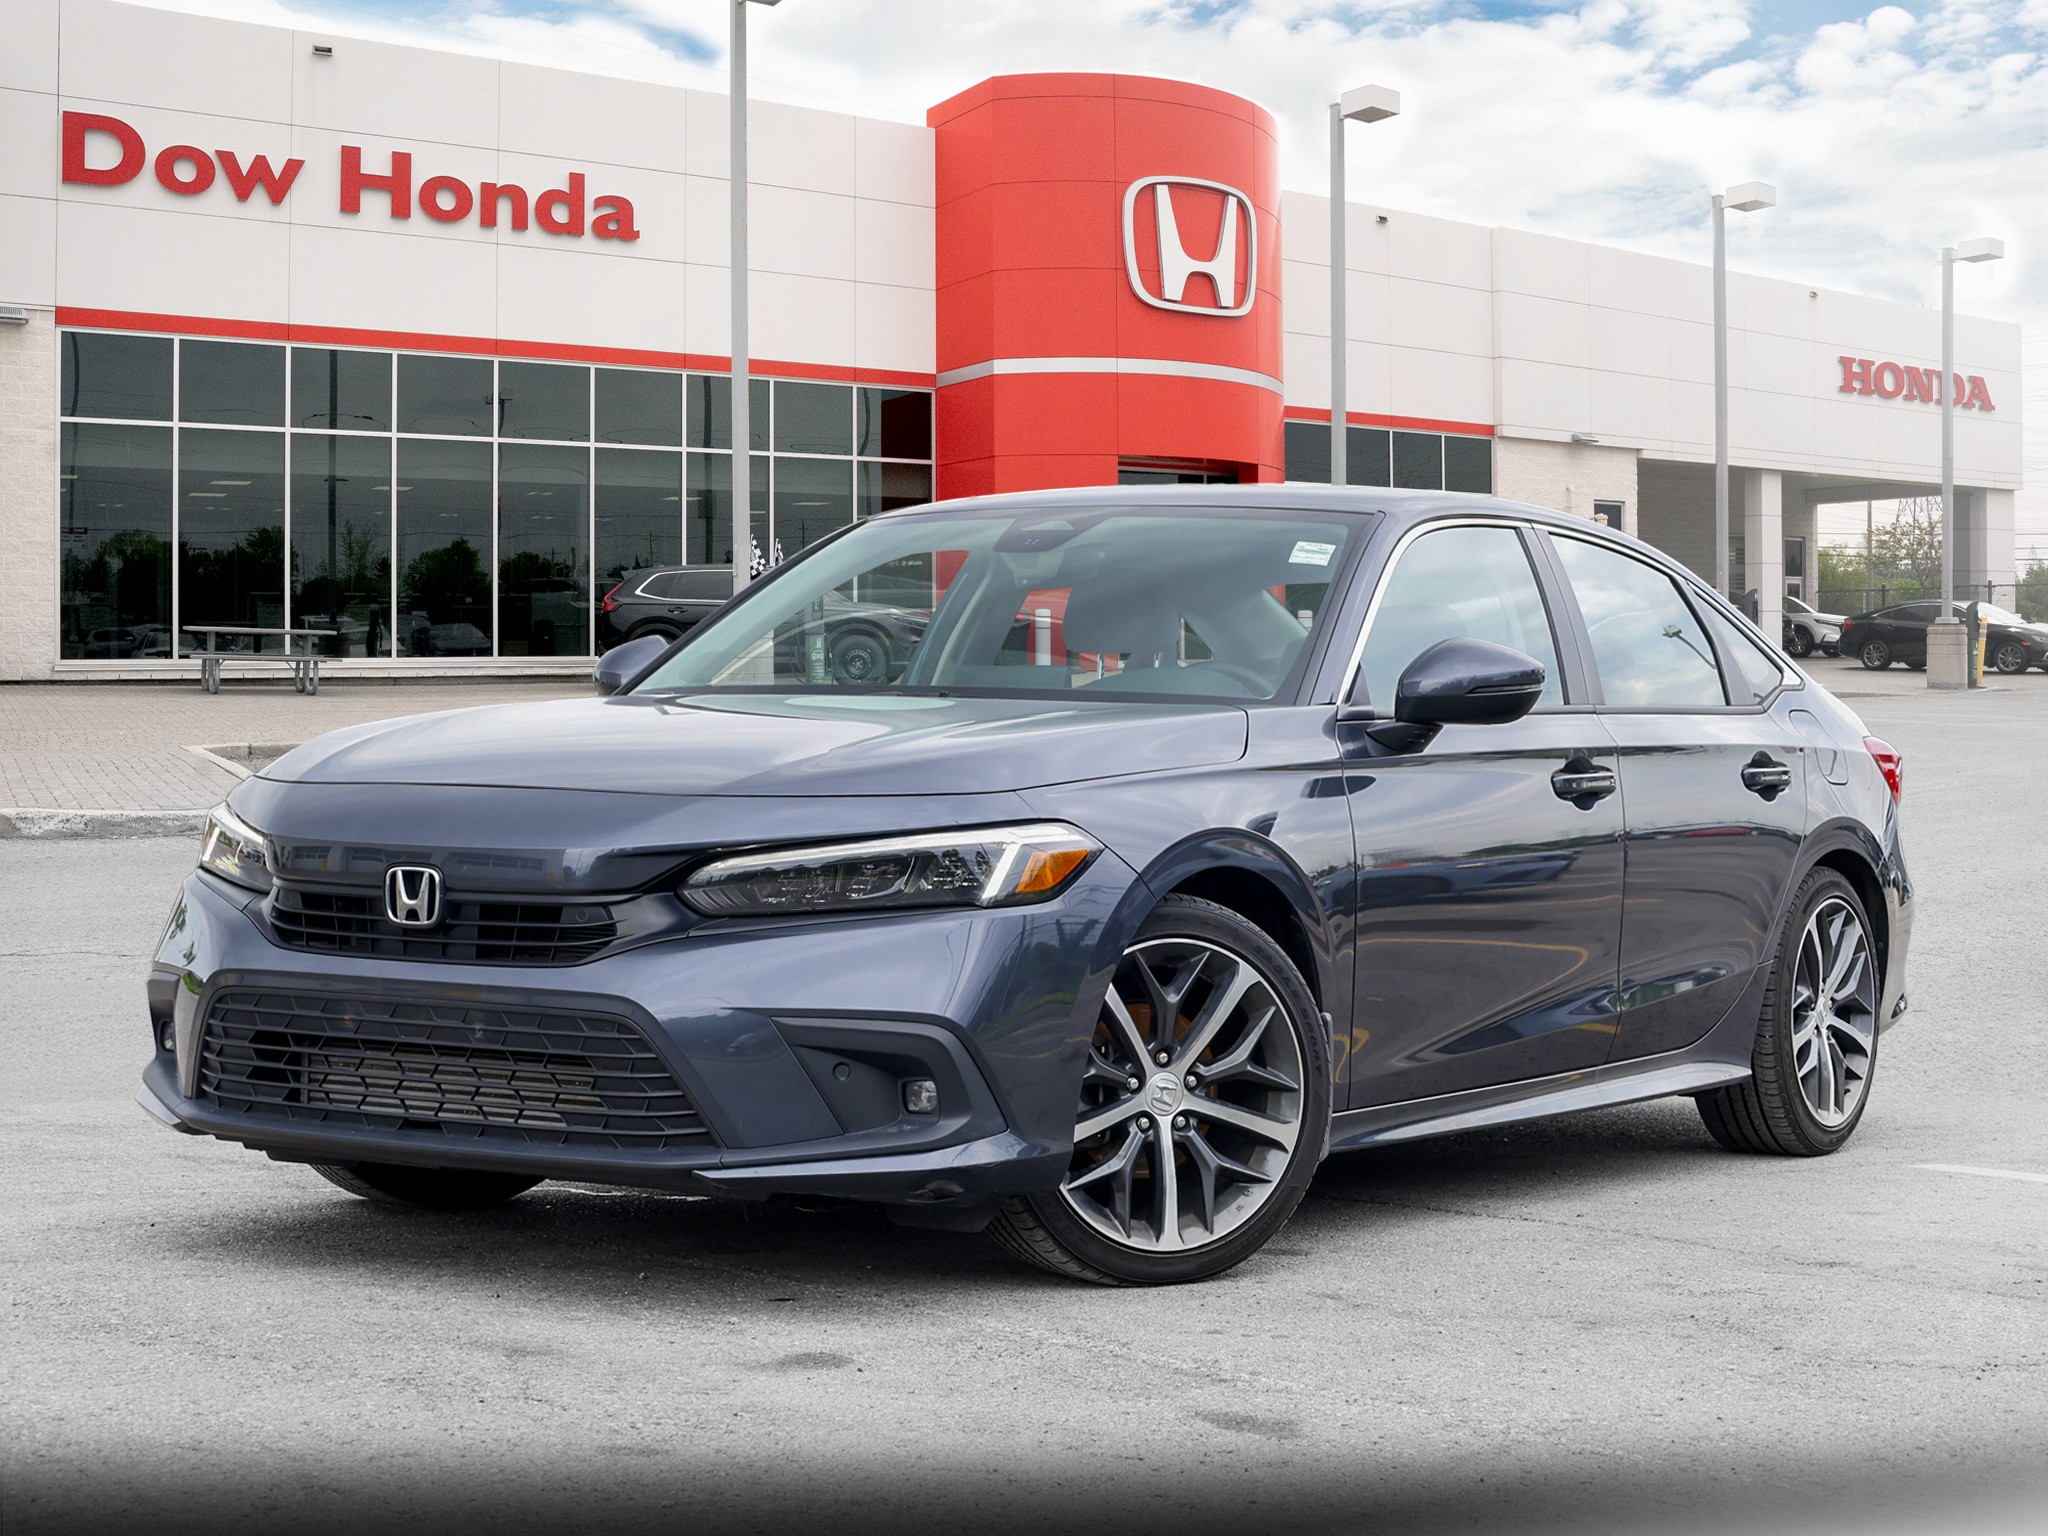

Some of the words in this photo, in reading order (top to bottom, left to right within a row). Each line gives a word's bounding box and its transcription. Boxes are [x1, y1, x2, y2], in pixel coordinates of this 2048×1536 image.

[62, 111, 305, 205] Dow
[340, 144, 640, 241] Honda
[1839, 355, 1995, 411] HONDA
